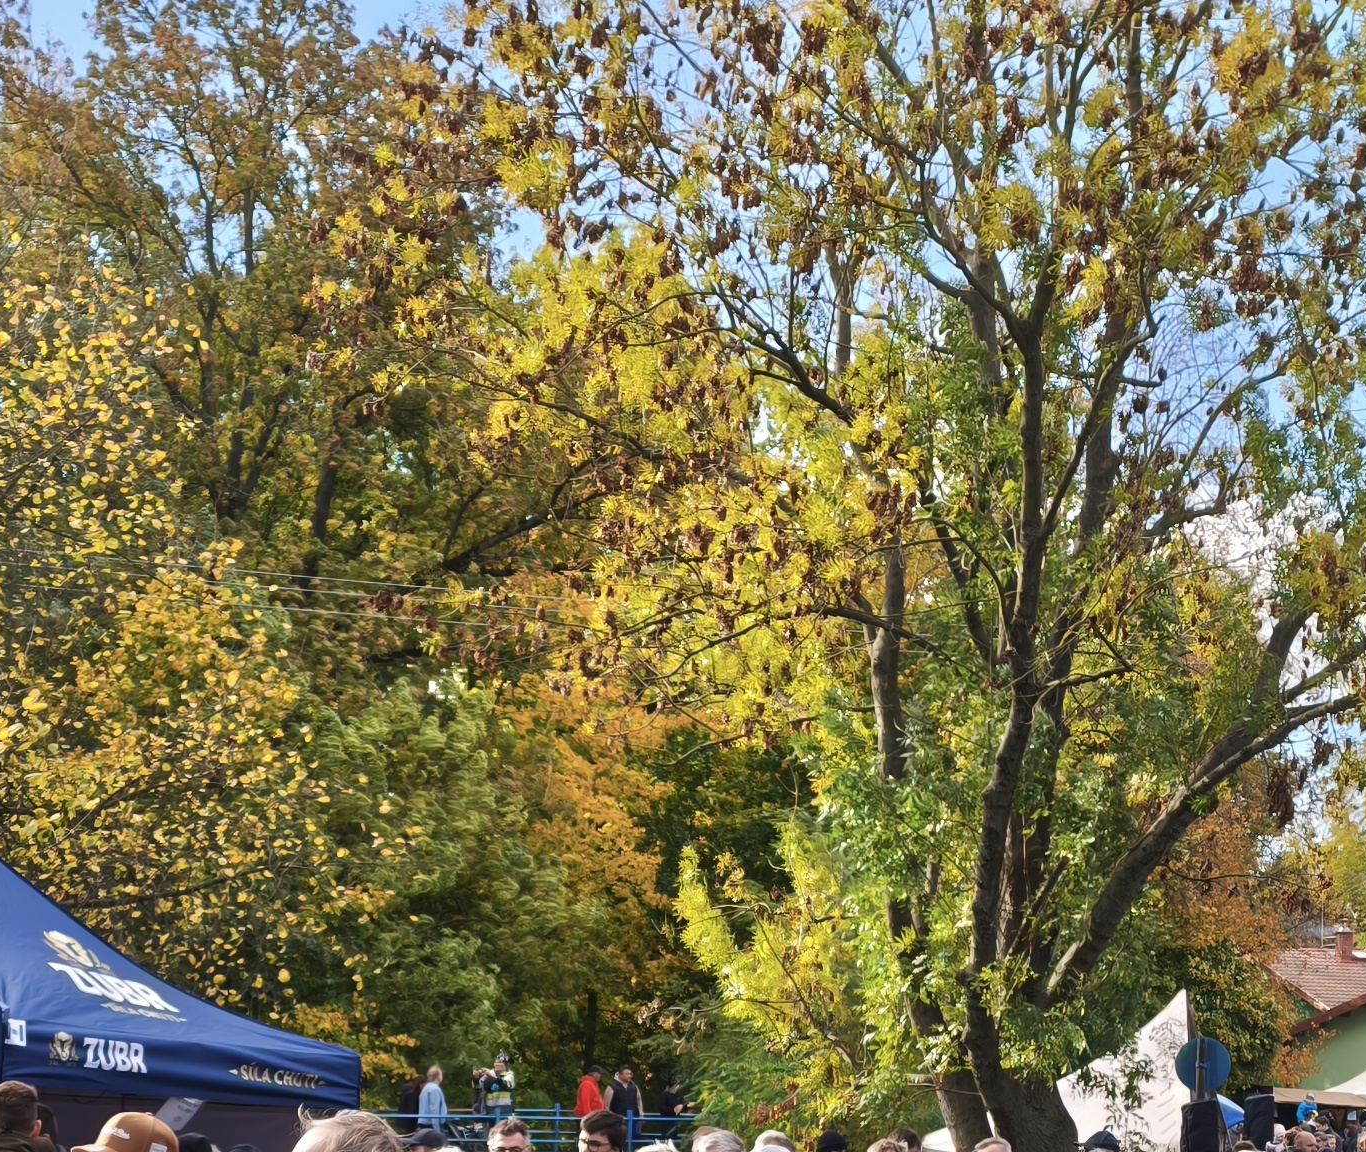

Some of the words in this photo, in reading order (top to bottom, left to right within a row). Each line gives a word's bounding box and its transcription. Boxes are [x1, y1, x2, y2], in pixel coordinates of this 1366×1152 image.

[46, 961, 181, 1014] ZUBR
[83, 1036, 148, 1074] ZUBR
[240, 1061, 272, 1085] SÍLA
[273, 1069, 319, 1090] CHUTI
